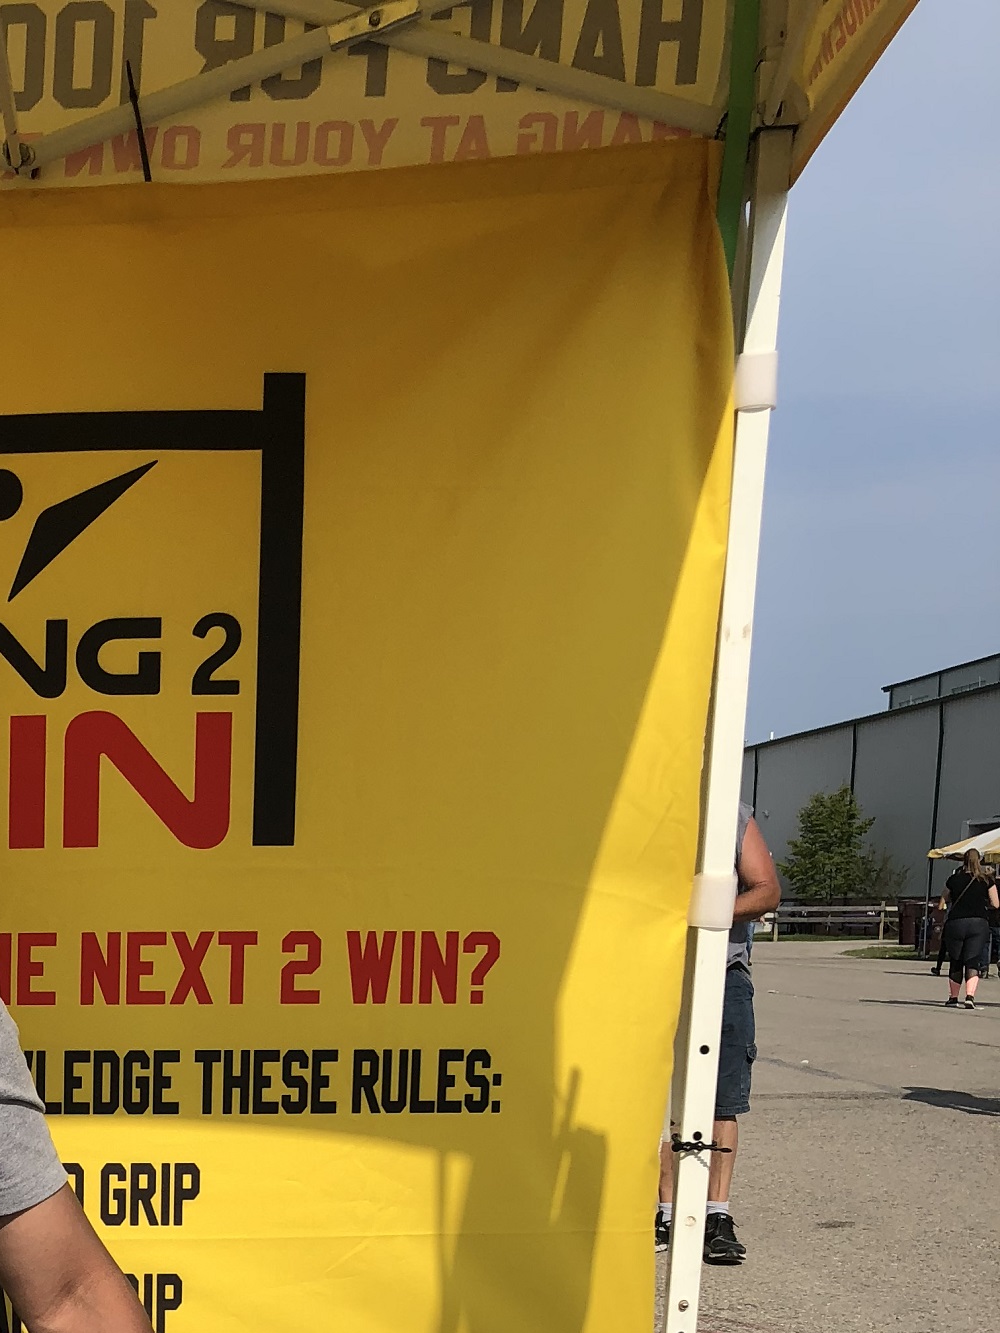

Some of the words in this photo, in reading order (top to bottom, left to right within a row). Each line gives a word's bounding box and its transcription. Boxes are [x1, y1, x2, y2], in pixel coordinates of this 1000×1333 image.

[191, 611, 243, 696] 2
[79, 931, 258, 1006] NEXT
[280, 930, 323, 1005] 2
[346, 930, 501, 1006] WIN?
[194, 1049, 339, 1115] THESE
[351, 1048, 503, 1114] RULES:
[100, 1162, 201, 1227] GRIP
